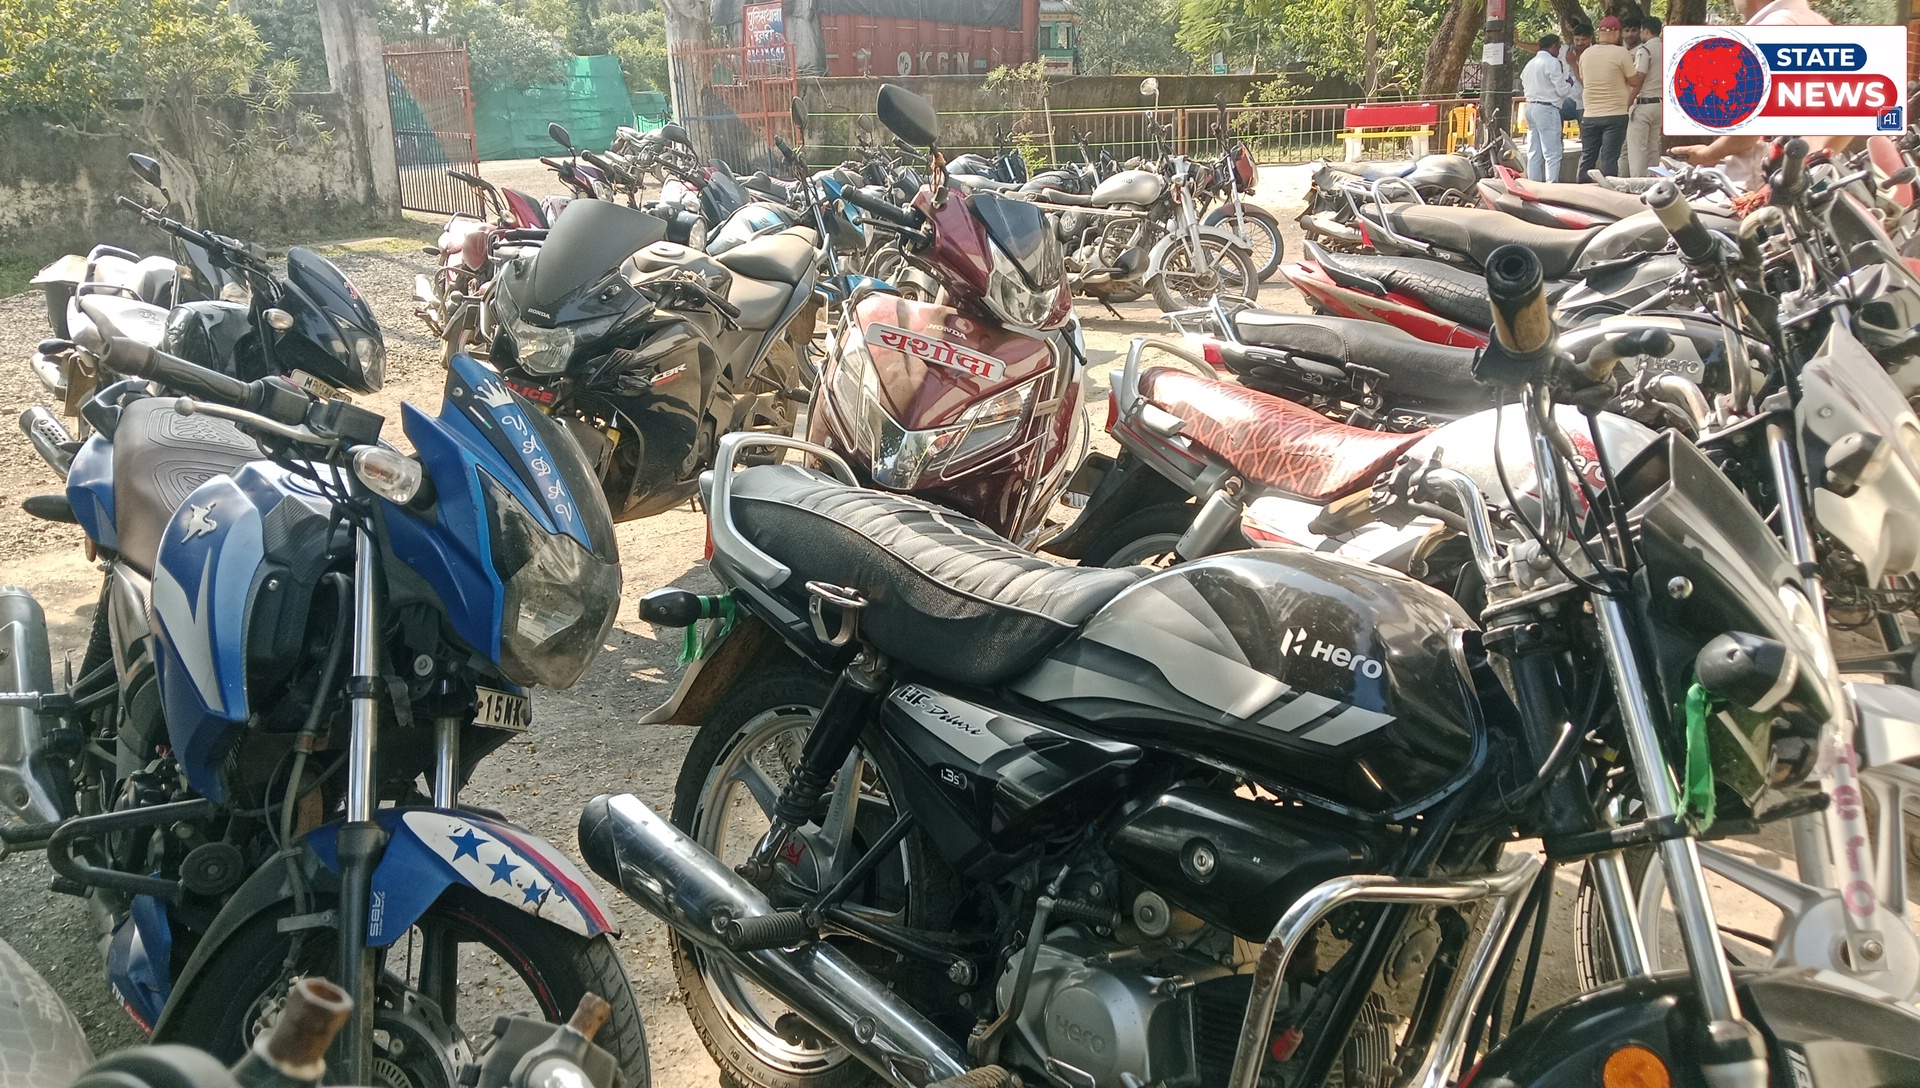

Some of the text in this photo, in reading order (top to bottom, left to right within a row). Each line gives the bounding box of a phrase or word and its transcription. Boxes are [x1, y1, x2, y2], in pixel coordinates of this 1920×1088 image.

[527, 307, 552, 319] HONDA
[926, 323, 968, 340] HONDA
[880, 329, 995, 378] यशोदा
[1652, 357, 1701, 374] Hero
[650, 362, 687, 384] CBR
[501, 413, 575, 523] YADAV
[1565, 454, 1615, 482] ero
[1310, 639, 1383, 679] Hero
[369, 891, 381, 937] ABS
